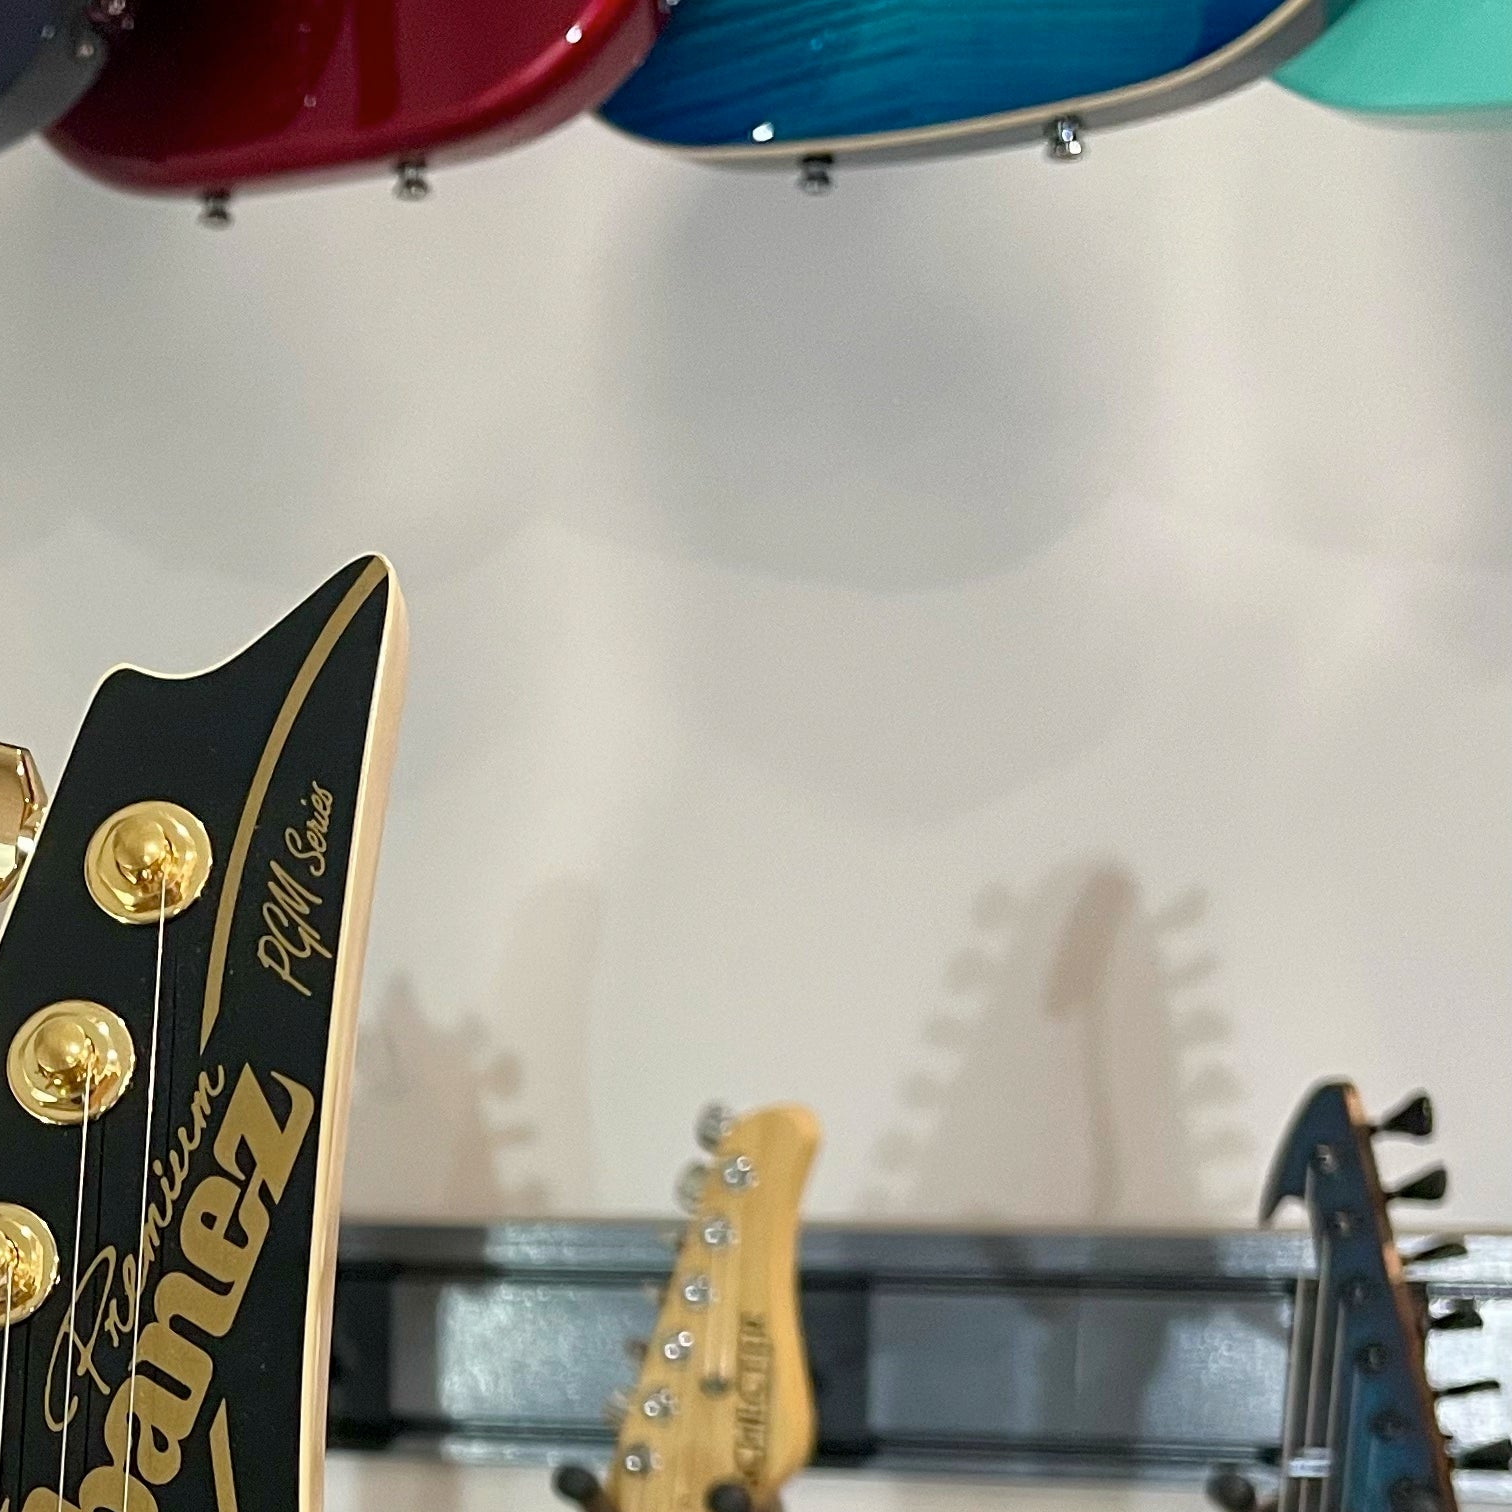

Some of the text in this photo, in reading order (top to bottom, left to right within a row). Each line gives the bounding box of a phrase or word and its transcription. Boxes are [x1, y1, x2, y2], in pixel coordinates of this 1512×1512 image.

[255, 780, 335, 997] PGM Series
[43, 1064, 226, 1433] Premium
